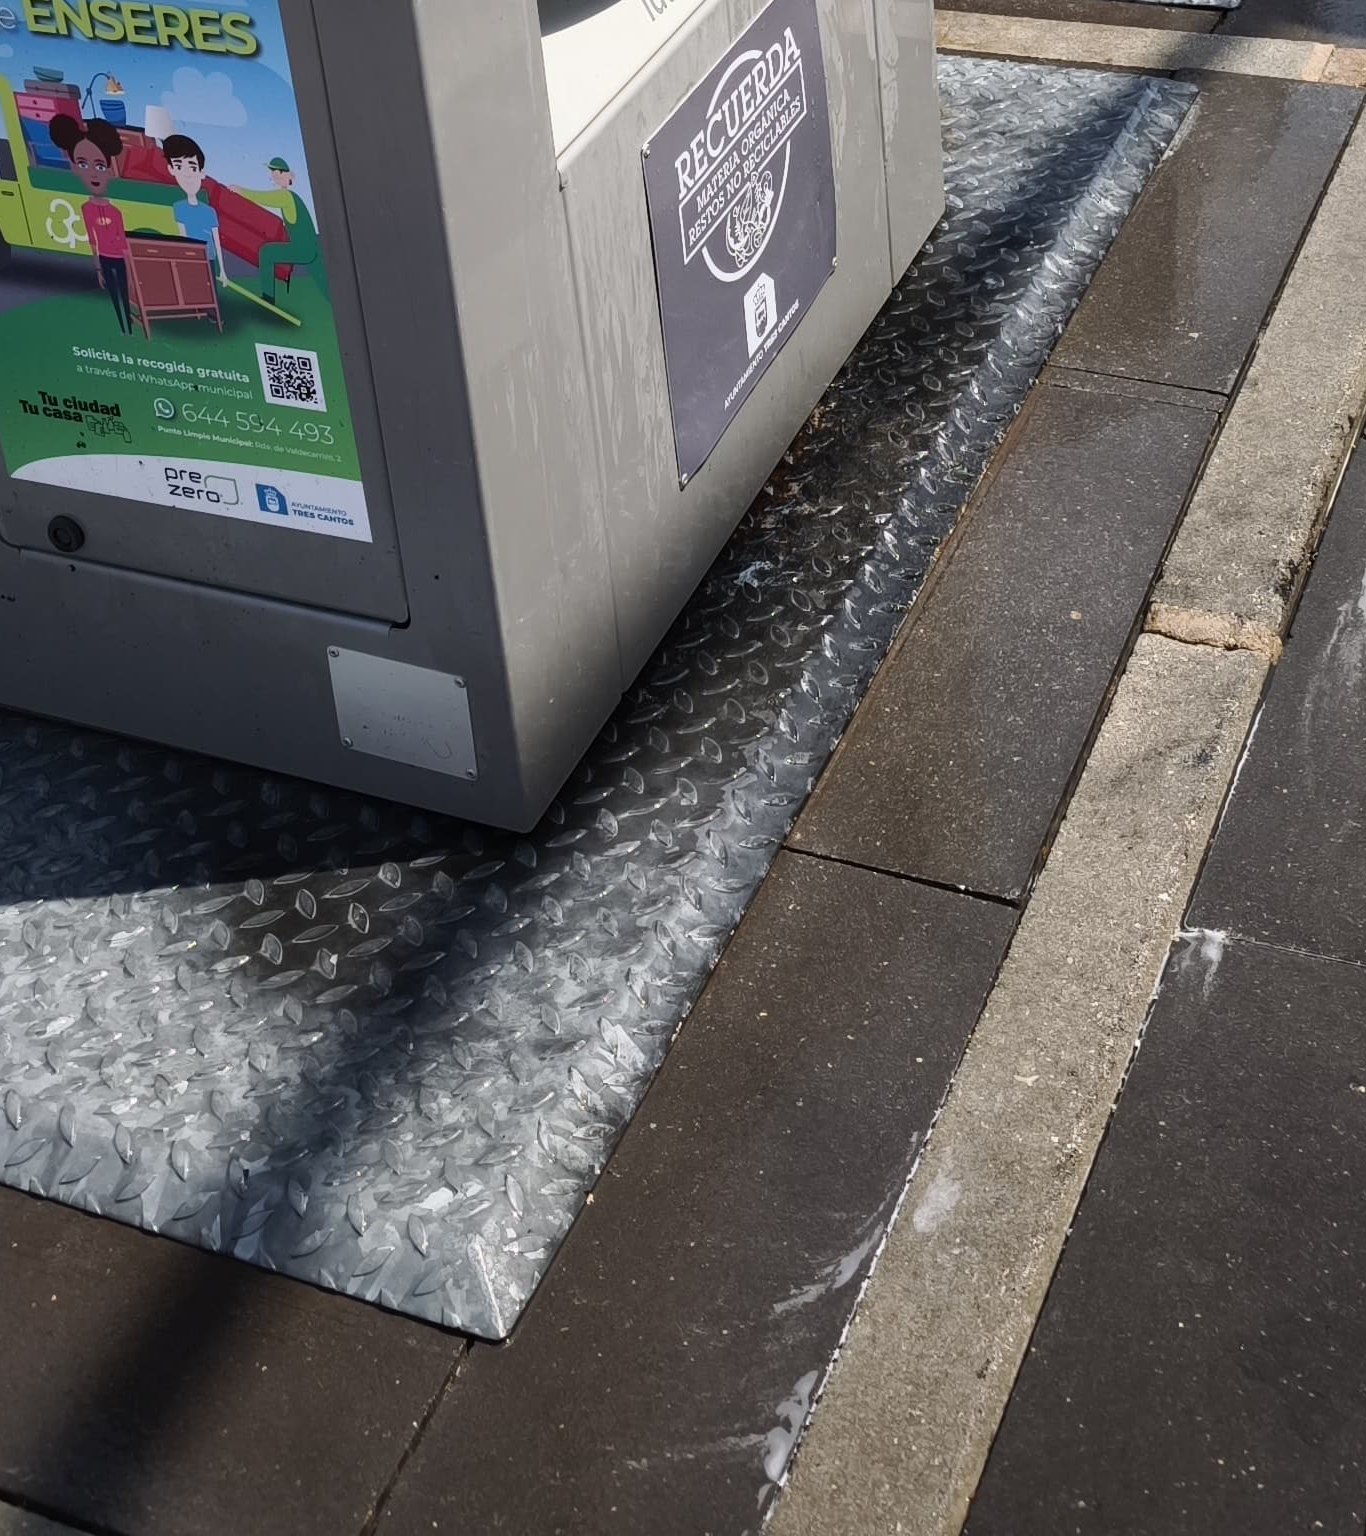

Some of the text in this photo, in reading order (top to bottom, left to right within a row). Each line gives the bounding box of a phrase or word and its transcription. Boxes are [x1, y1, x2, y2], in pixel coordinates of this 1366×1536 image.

[674, 26, 801, 200] RECUERDA
[696, 88, 791, 213] MATERIA ORGÁNICA
[688, 95, 801, 247] RESTOS NO RECICLABLES
[72, 346, 250, 384] Solicita la recogida gratuita
[724, 349, 764, 412] AYUNTAMIENTO
[85, 365, 117, 379] través
[119, 369, 136, 382] del
[138, 372, 196, 392] WhatsApp
[197, 383, 253, 401] municipal
[19, 399, 84, 423] Tu casa
[38, 390, 121, 418] Tu ciudad
[157, 425, 182, 436] Punto
[183, 430, 211, 441] Limpio
[182, 402, 335, 446] 644 594 493
[164, 467, 202, 483] pre
[167, 483, 221, 504] zero
[291, 501, 347, 517] AYUNTAMIENTO
[292, 509, 355, 526] TRES CANTOS
